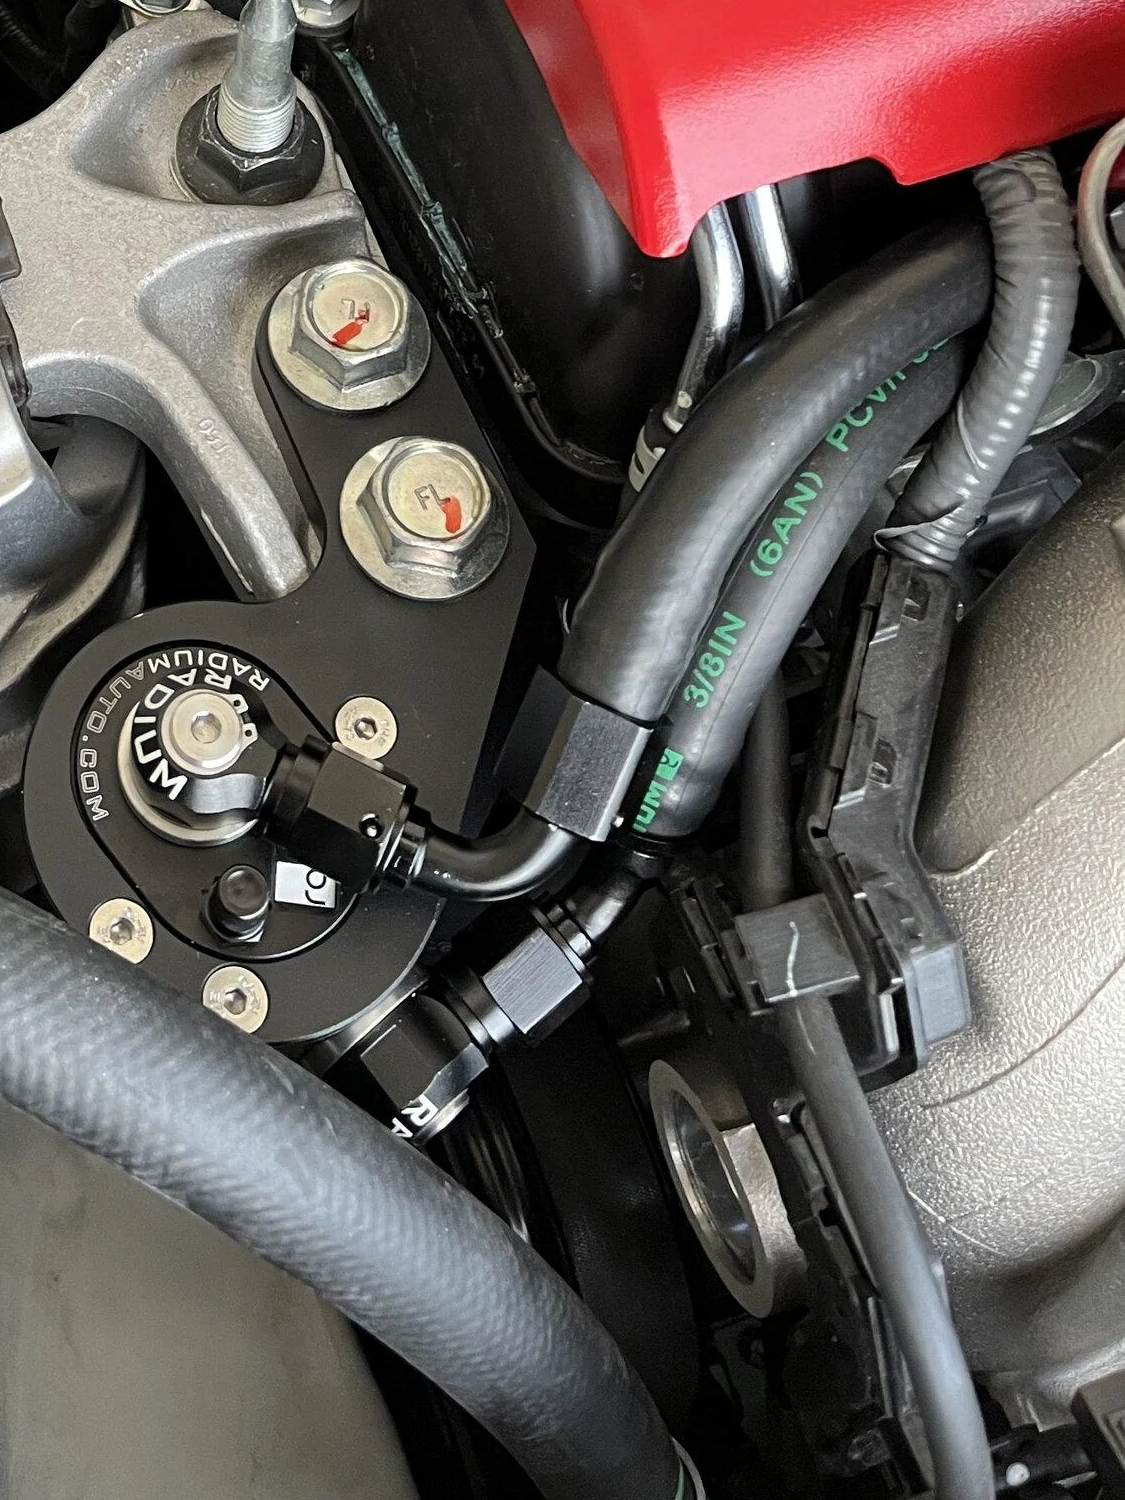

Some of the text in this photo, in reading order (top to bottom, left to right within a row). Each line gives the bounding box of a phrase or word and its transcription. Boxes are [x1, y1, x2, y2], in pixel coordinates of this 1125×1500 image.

[683, 611, 747, 709] 3/8IN
[750, 471, 824, 578] (6AN)
[134, 668, 233, 801] RADIUM
